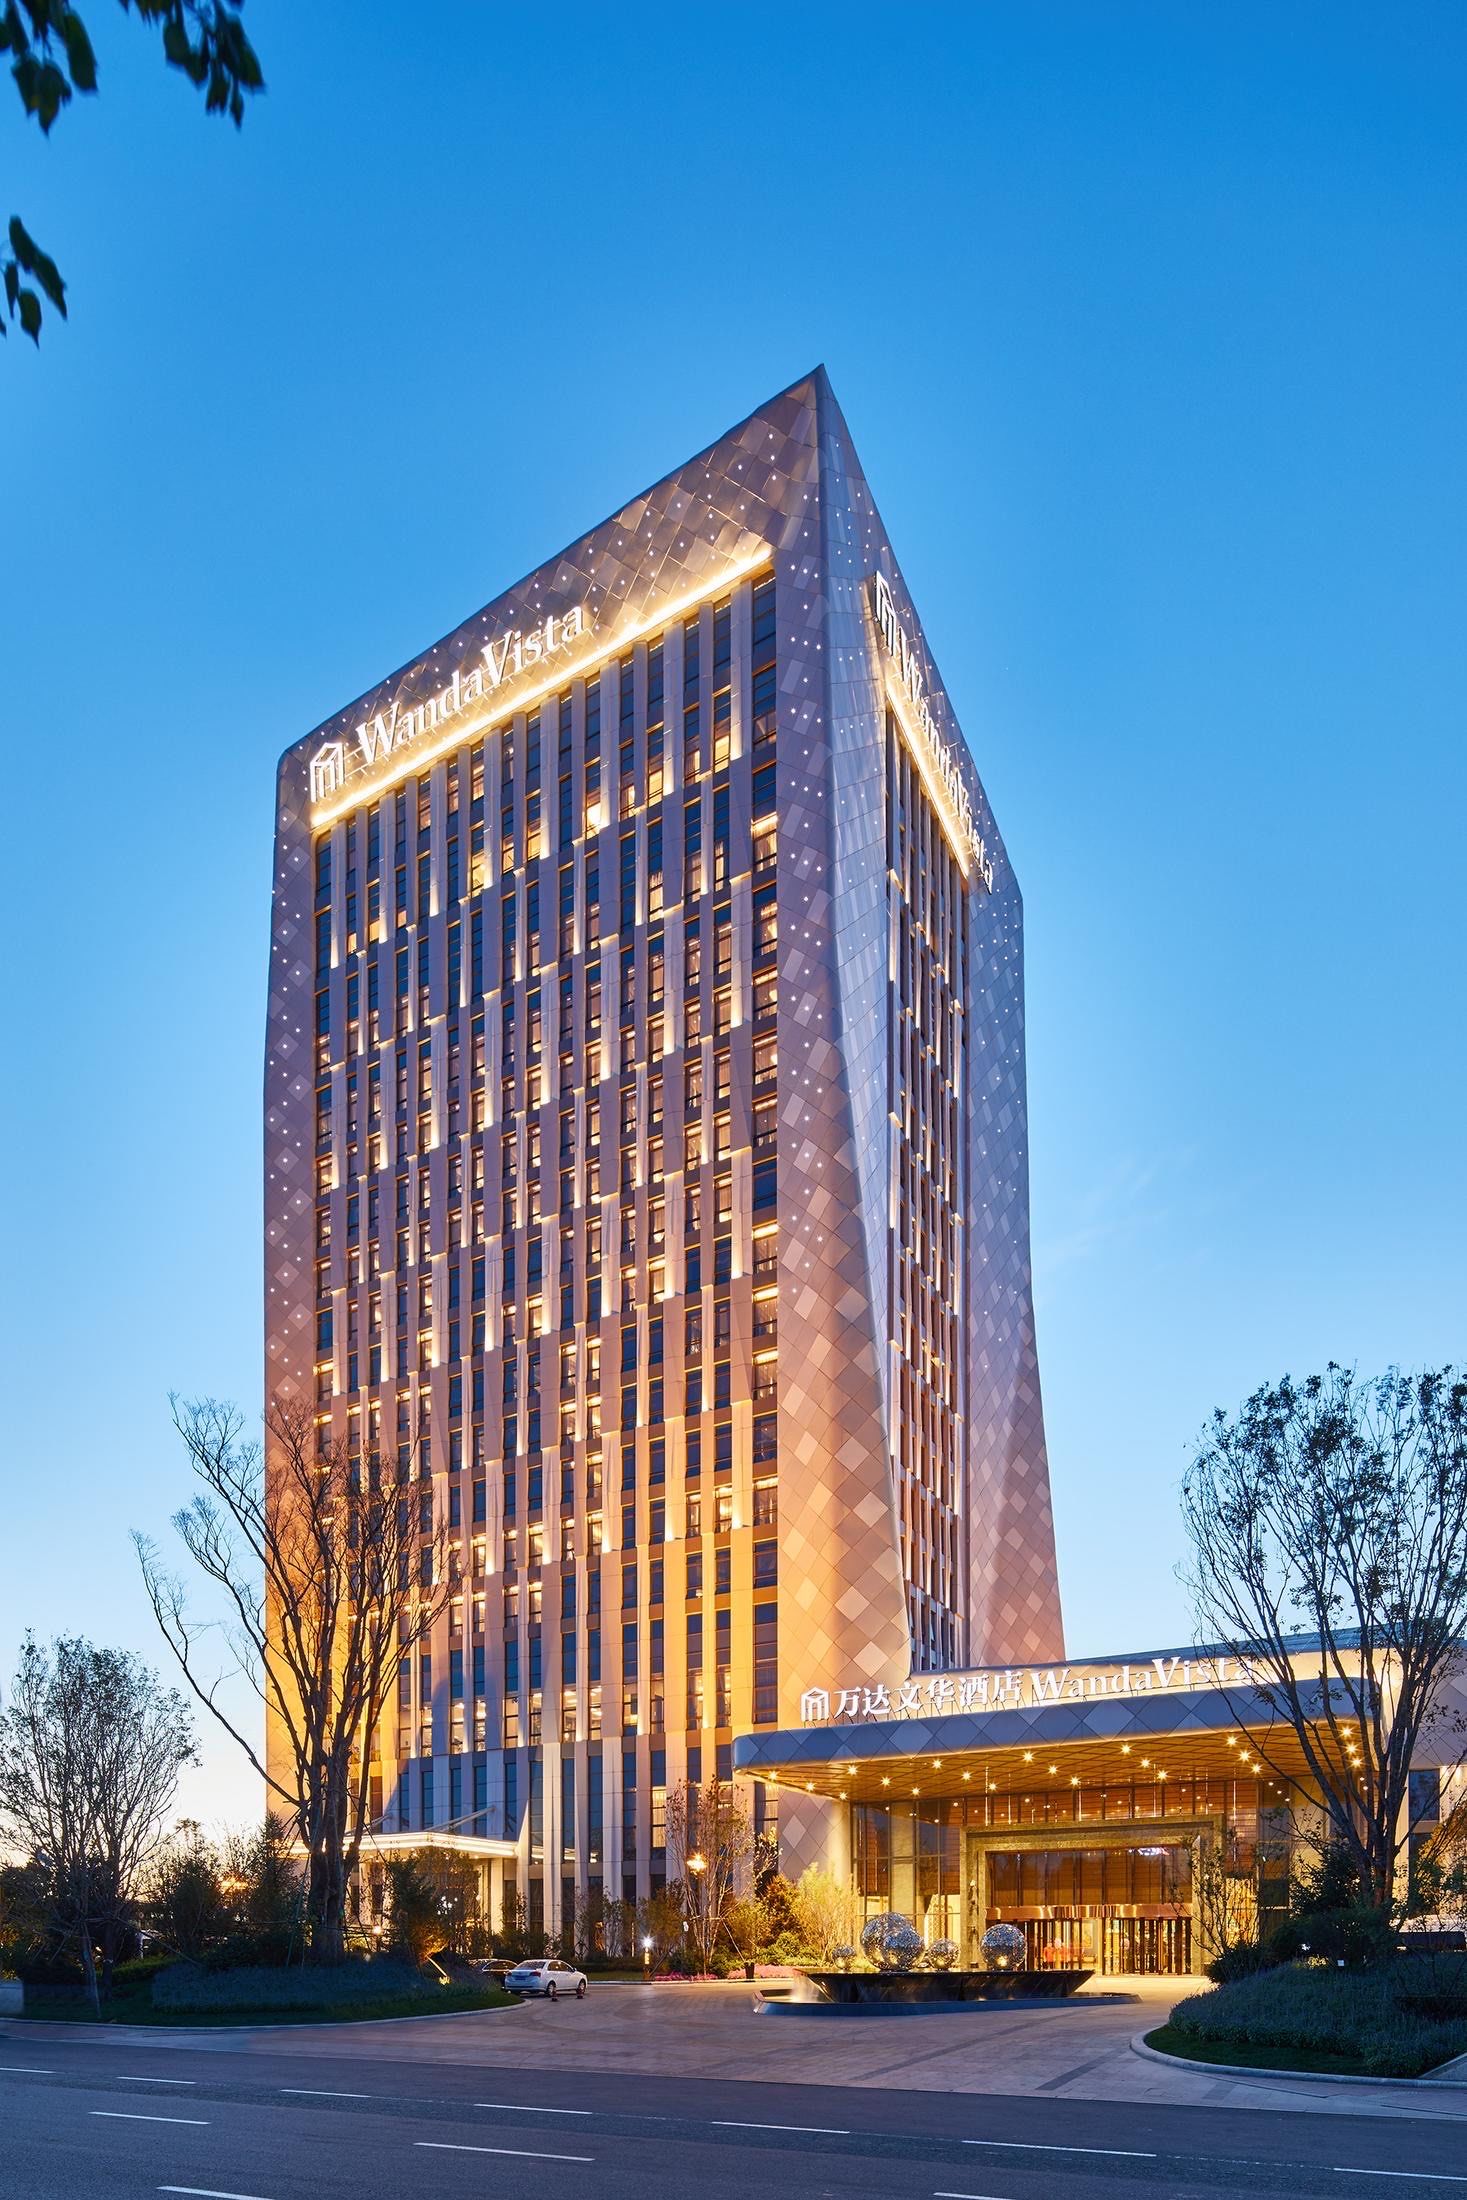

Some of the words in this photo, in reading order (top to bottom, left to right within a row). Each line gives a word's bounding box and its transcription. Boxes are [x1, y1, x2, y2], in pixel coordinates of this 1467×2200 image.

[834, 1670, 1023, 1719] 万达文华酒店
